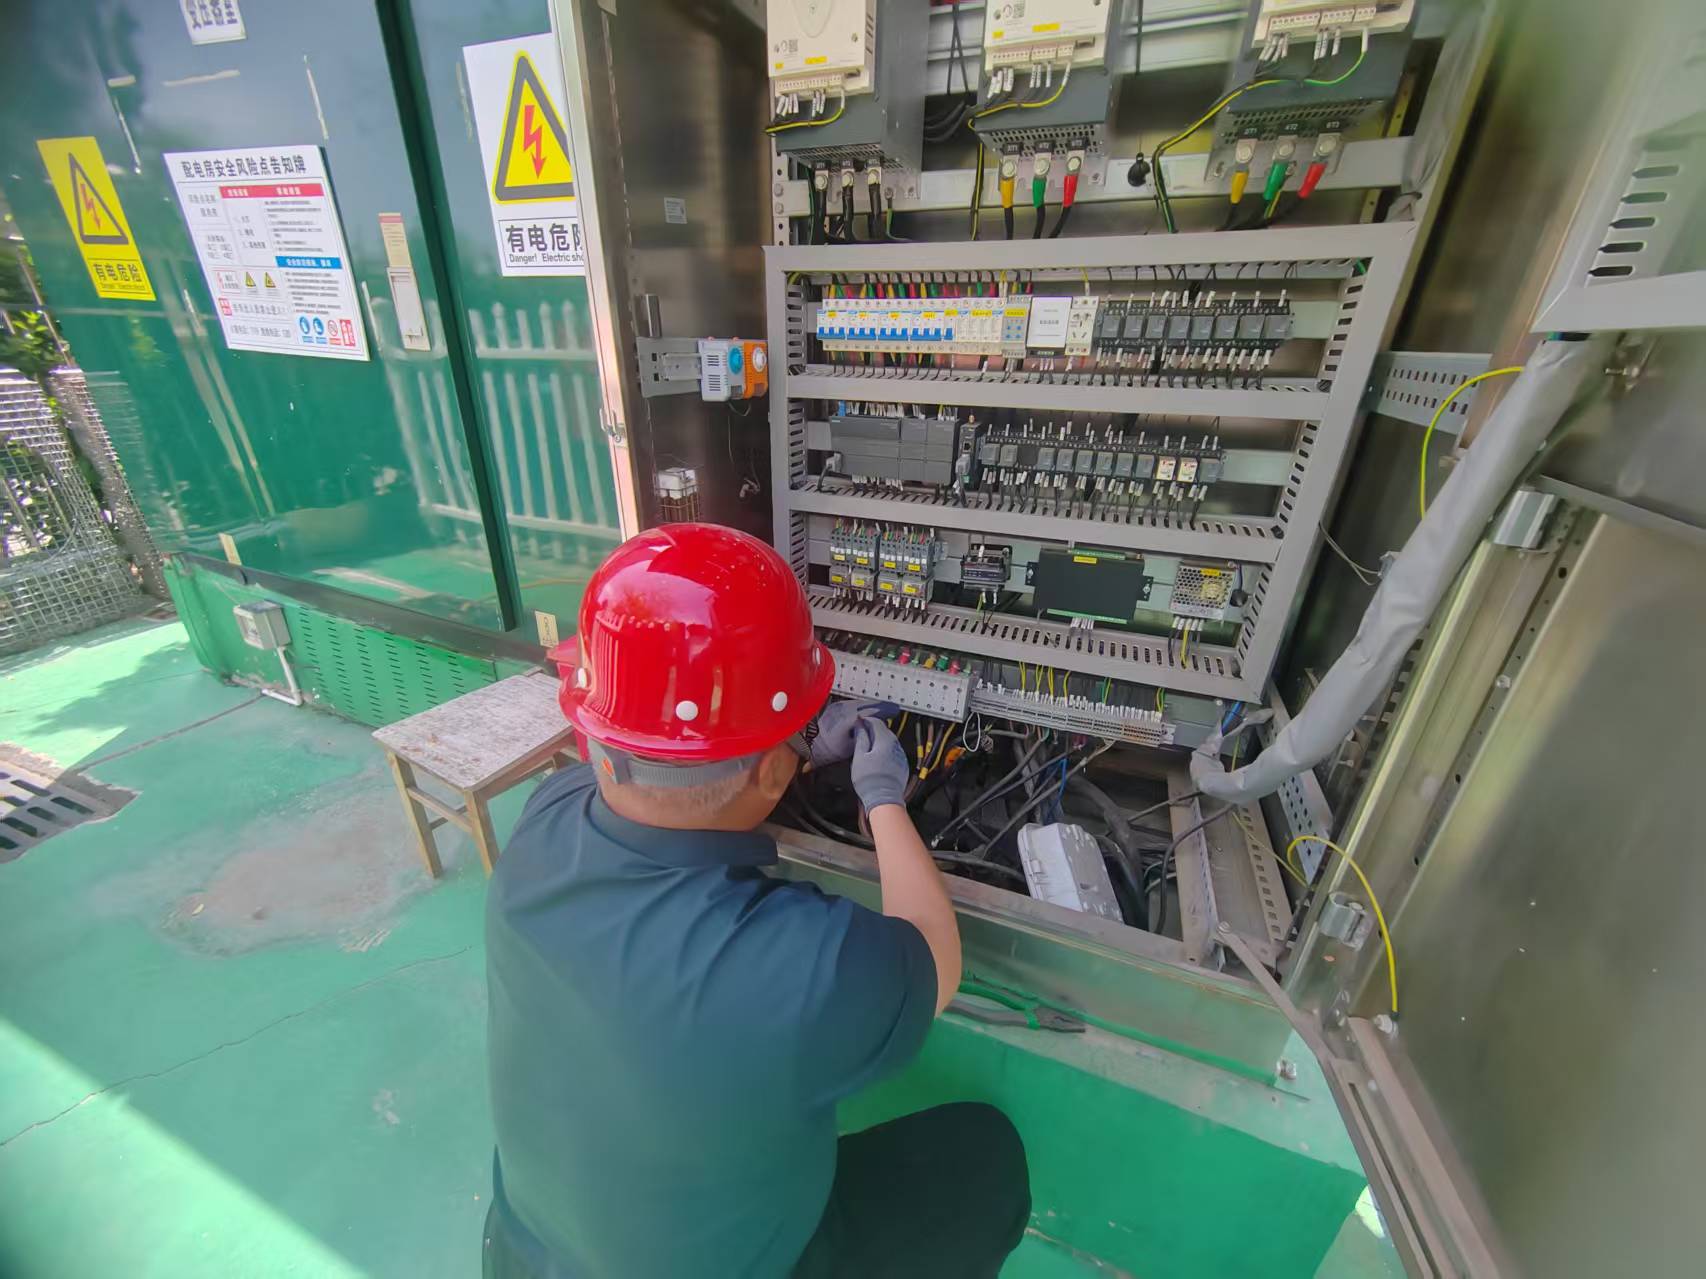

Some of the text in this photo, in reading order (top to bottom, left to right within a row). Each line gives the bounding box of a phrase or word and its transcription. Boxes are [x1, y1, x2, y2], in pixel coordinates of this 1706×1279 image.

[181, 155, 306, 178] 配电房安全风险点告知牌
[509, 253, 537, 264] Danger!
[542, 252, 570, 263] Electric
[93, 263, 142, 282] 有电危险
